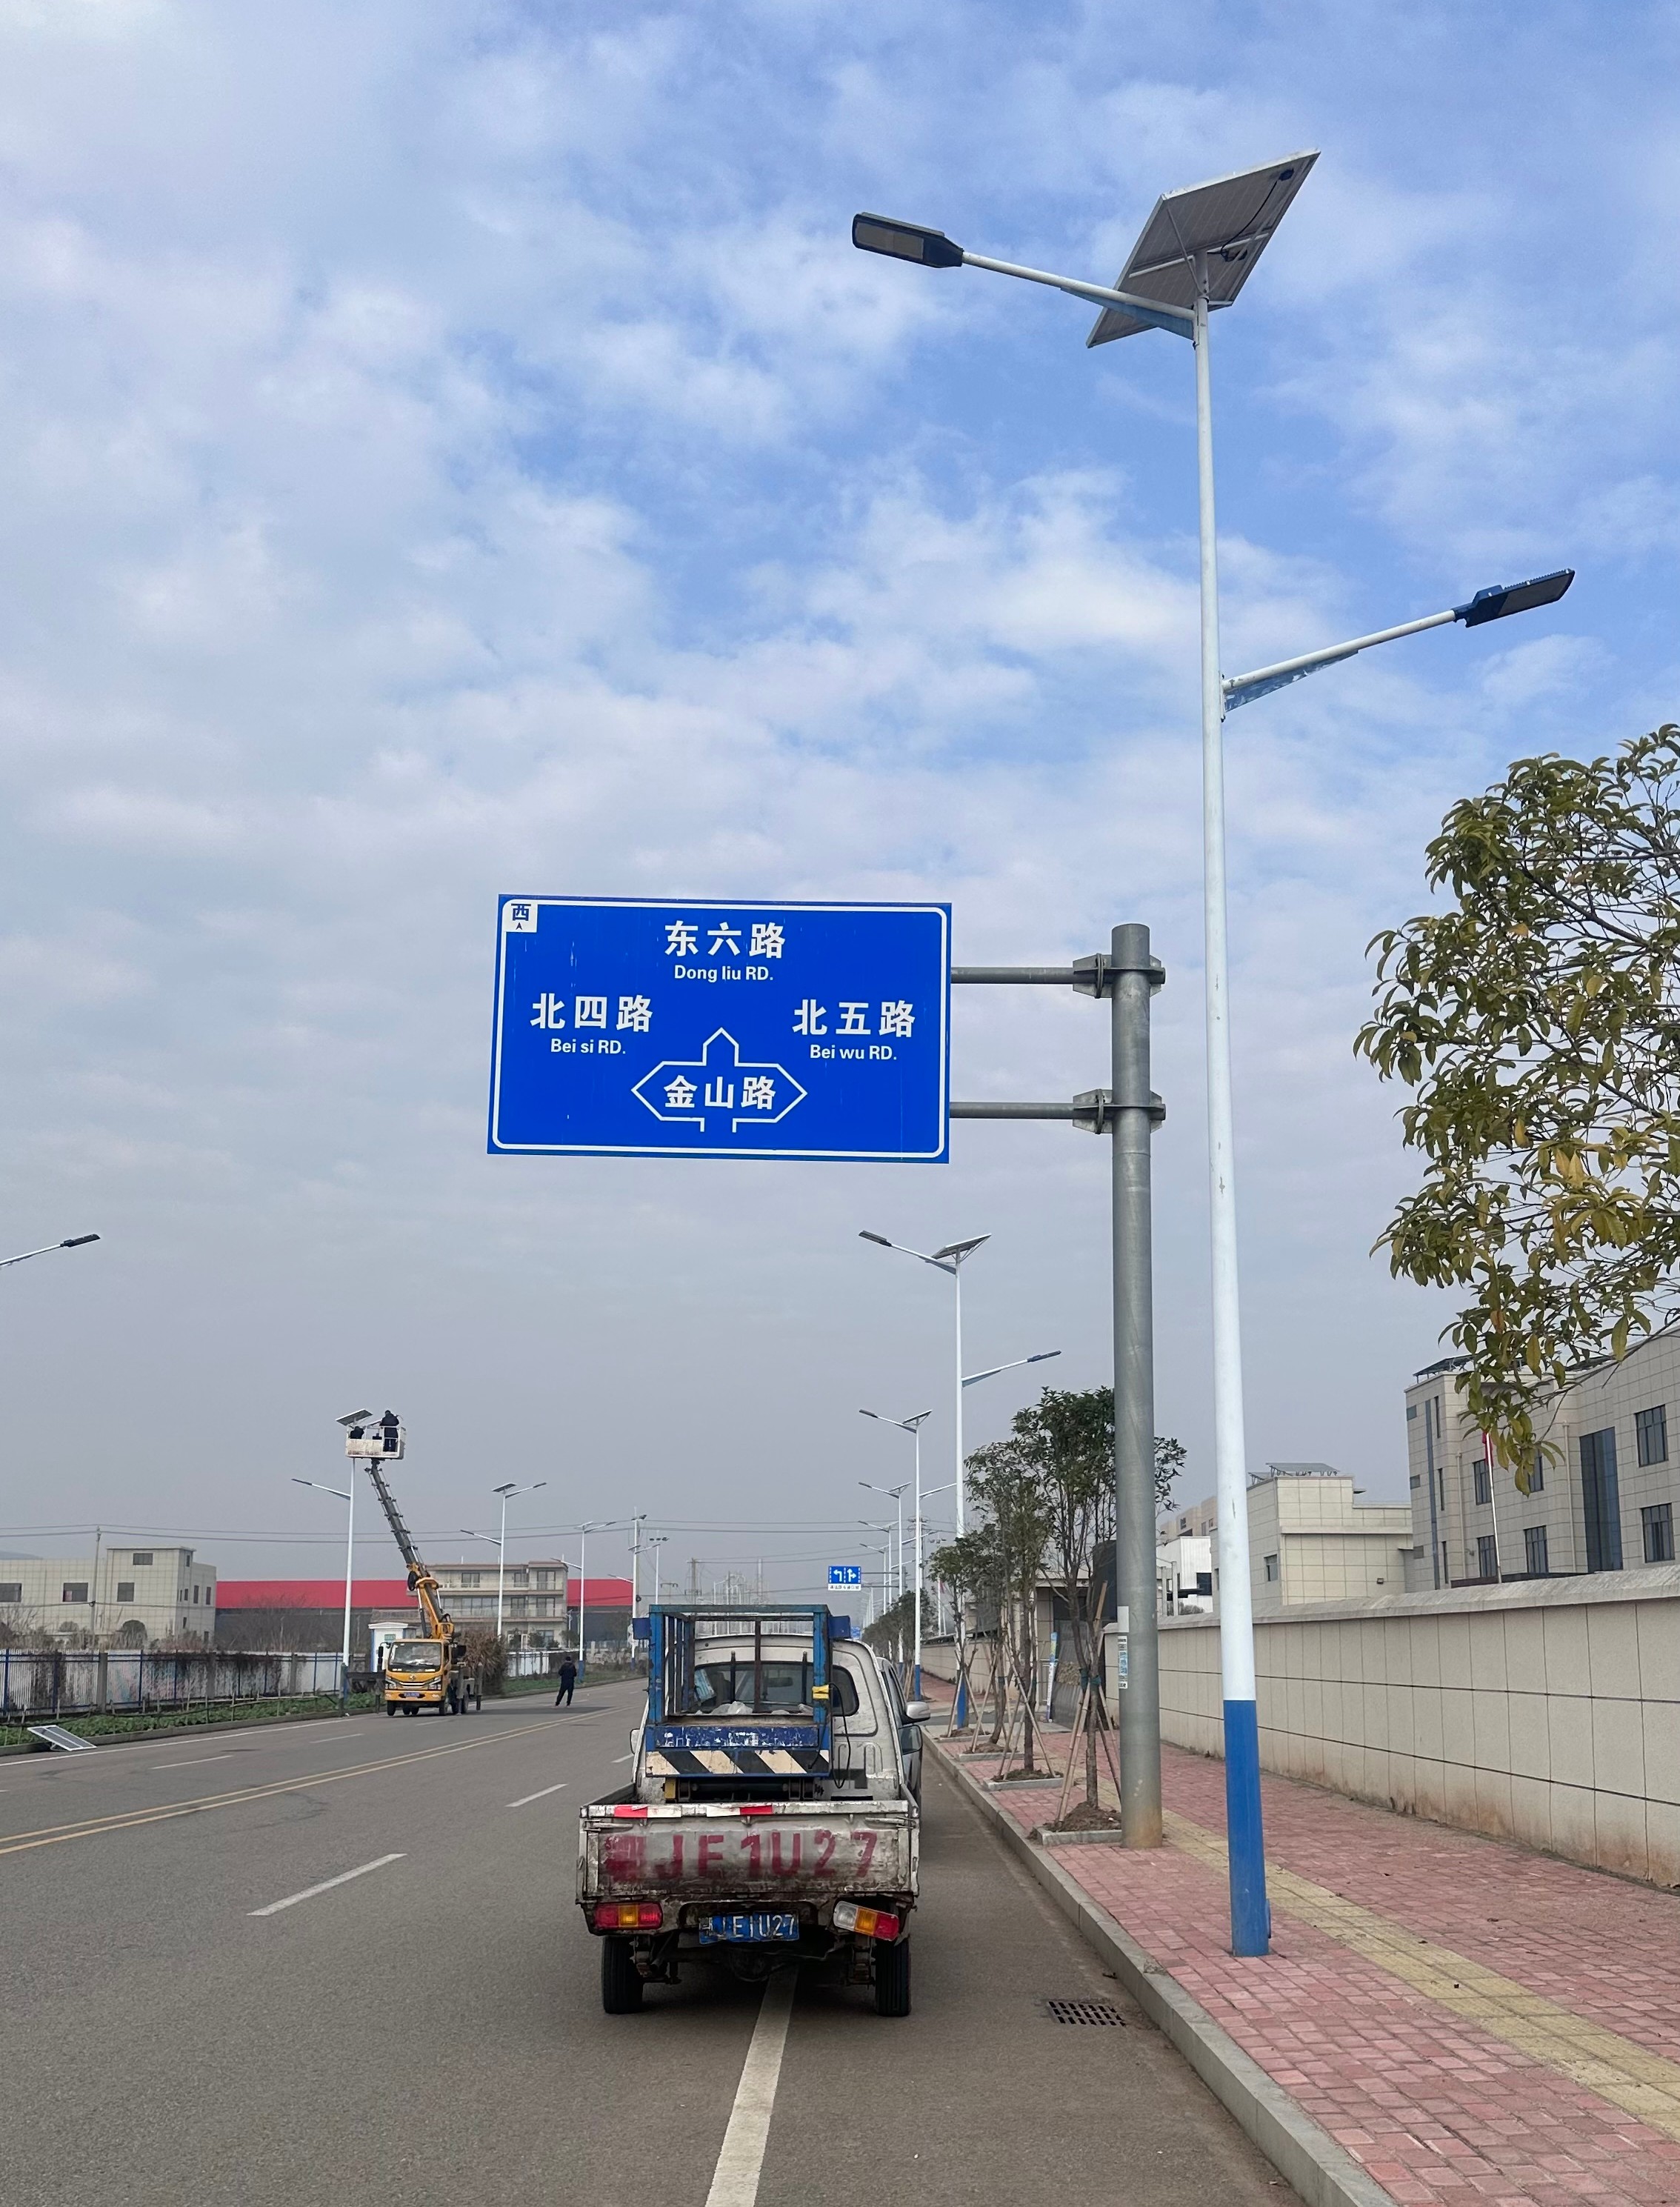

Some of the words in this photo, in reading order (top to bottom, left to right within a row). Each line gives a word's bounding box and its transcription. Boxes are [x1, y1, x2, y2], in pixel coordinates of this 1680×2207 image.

[510, 903, 532, 922] 西
[664, 920, 785, 959] 东六路
[674, 965, 718, 983] Dong
[721, 965, 741, 980] liu
[745, 966, 773, 981] RD.
[530, 993, 653, 1033] 北四路
[792, 999, 916, 1038] 北五路
[550, 1038, 576, 1053] Bei
[580, 1039, 594, 1053] si
[598, 1039, 626, 1054] RD.
[810, 1044, 836, 1059] Bei
[839, 1048, 864, 1059] wu
[869, 1045, 897, 1060] RD.
[663, 1074, 776, 1110] 金山路
